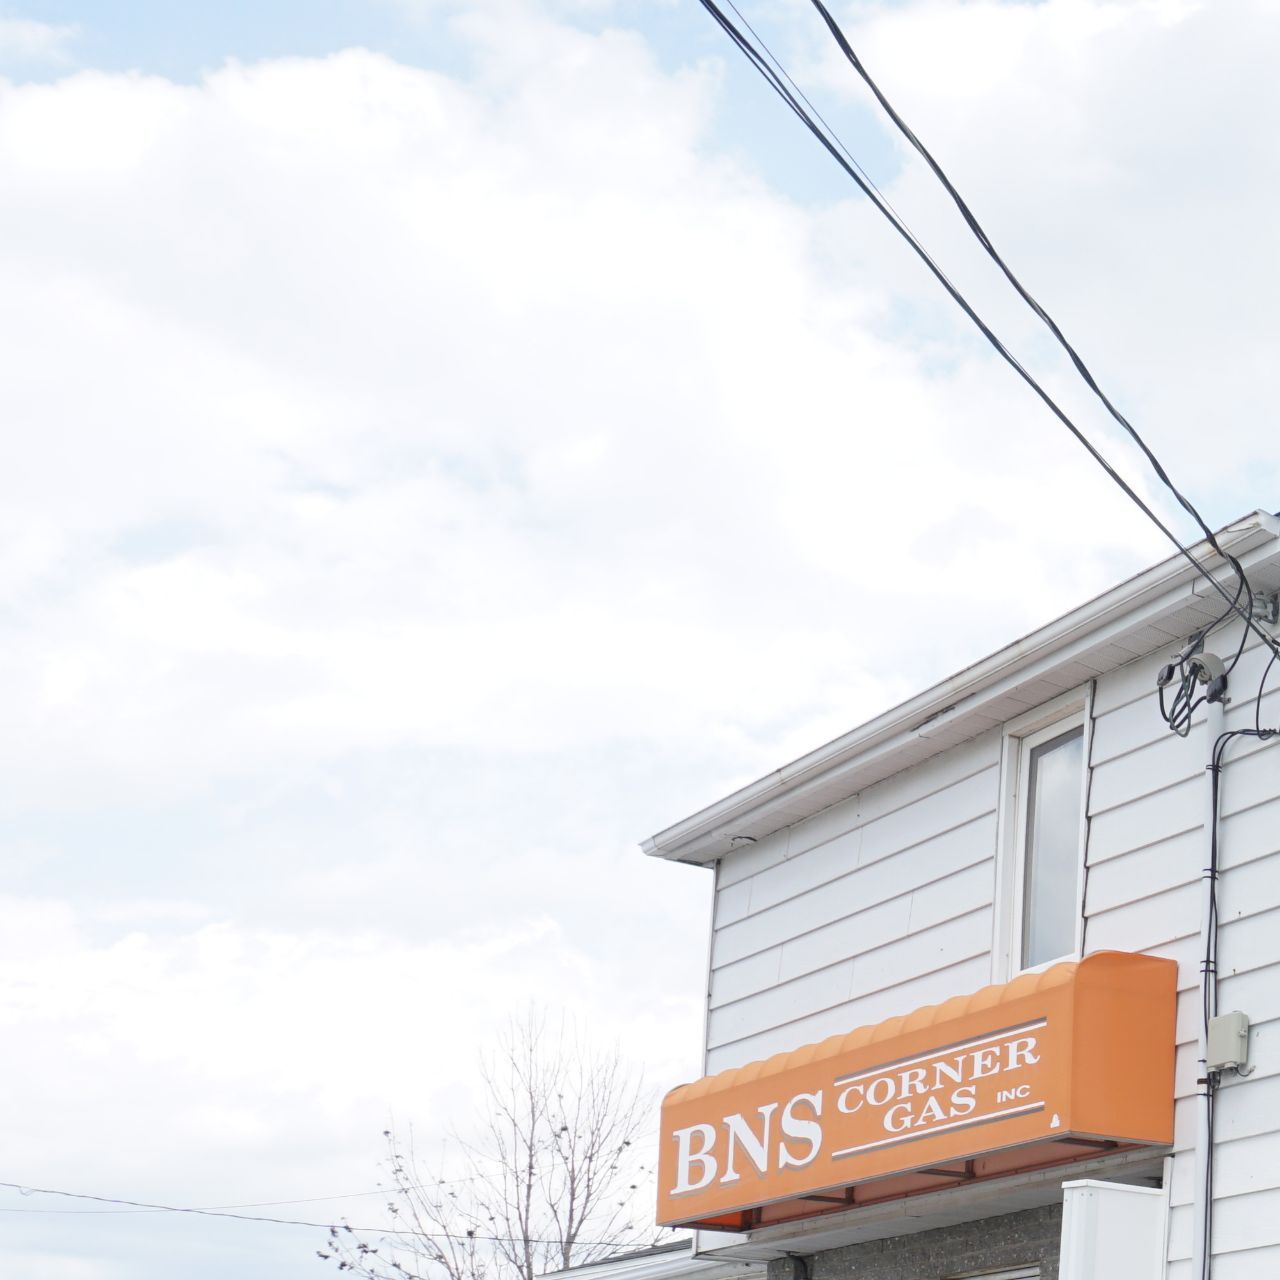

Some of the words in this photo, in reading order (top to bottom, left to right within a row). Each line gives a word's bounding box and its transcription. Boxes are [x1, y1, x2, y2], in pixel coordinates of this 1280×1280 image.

[837, 1036, 1040, 1114] CORNER
[883, 1086, 978, 1133] GAS
[996, 1084, 1031, 1104] INC
[669, 1089, 824, 1197] BNS
